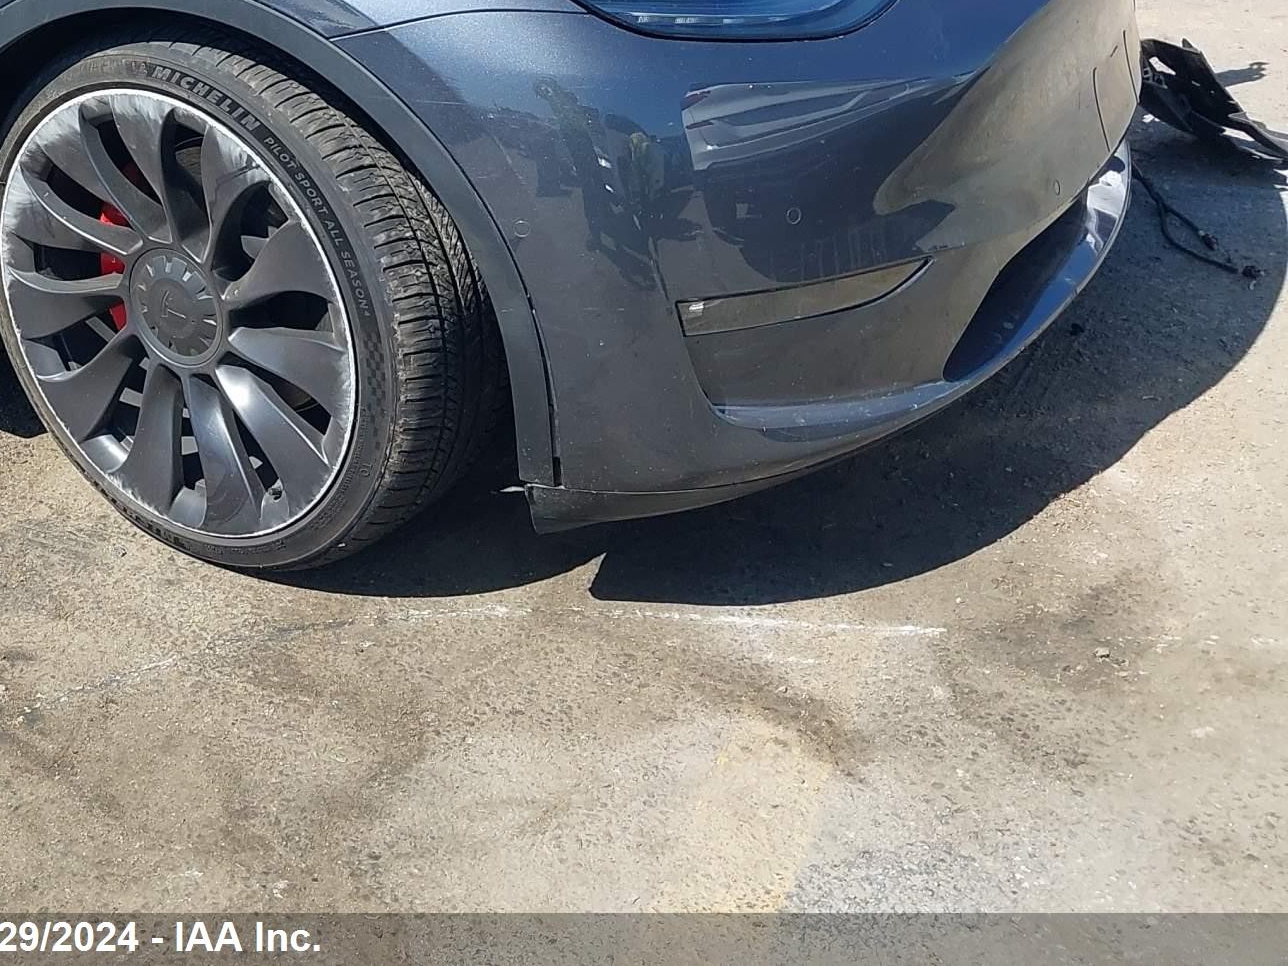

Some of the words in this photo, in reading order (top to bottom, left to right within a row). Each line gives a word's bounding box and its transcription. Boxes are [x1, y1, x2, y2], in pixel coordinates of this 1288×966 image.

[152, 66, 261, 132] MICHELIN
[263, 137, 298, 171] PILOT
[295, 173, 327, 217] SPORT
[325, 220, 345, 247] ALL
[341, 250, 369, 308] SEASON
